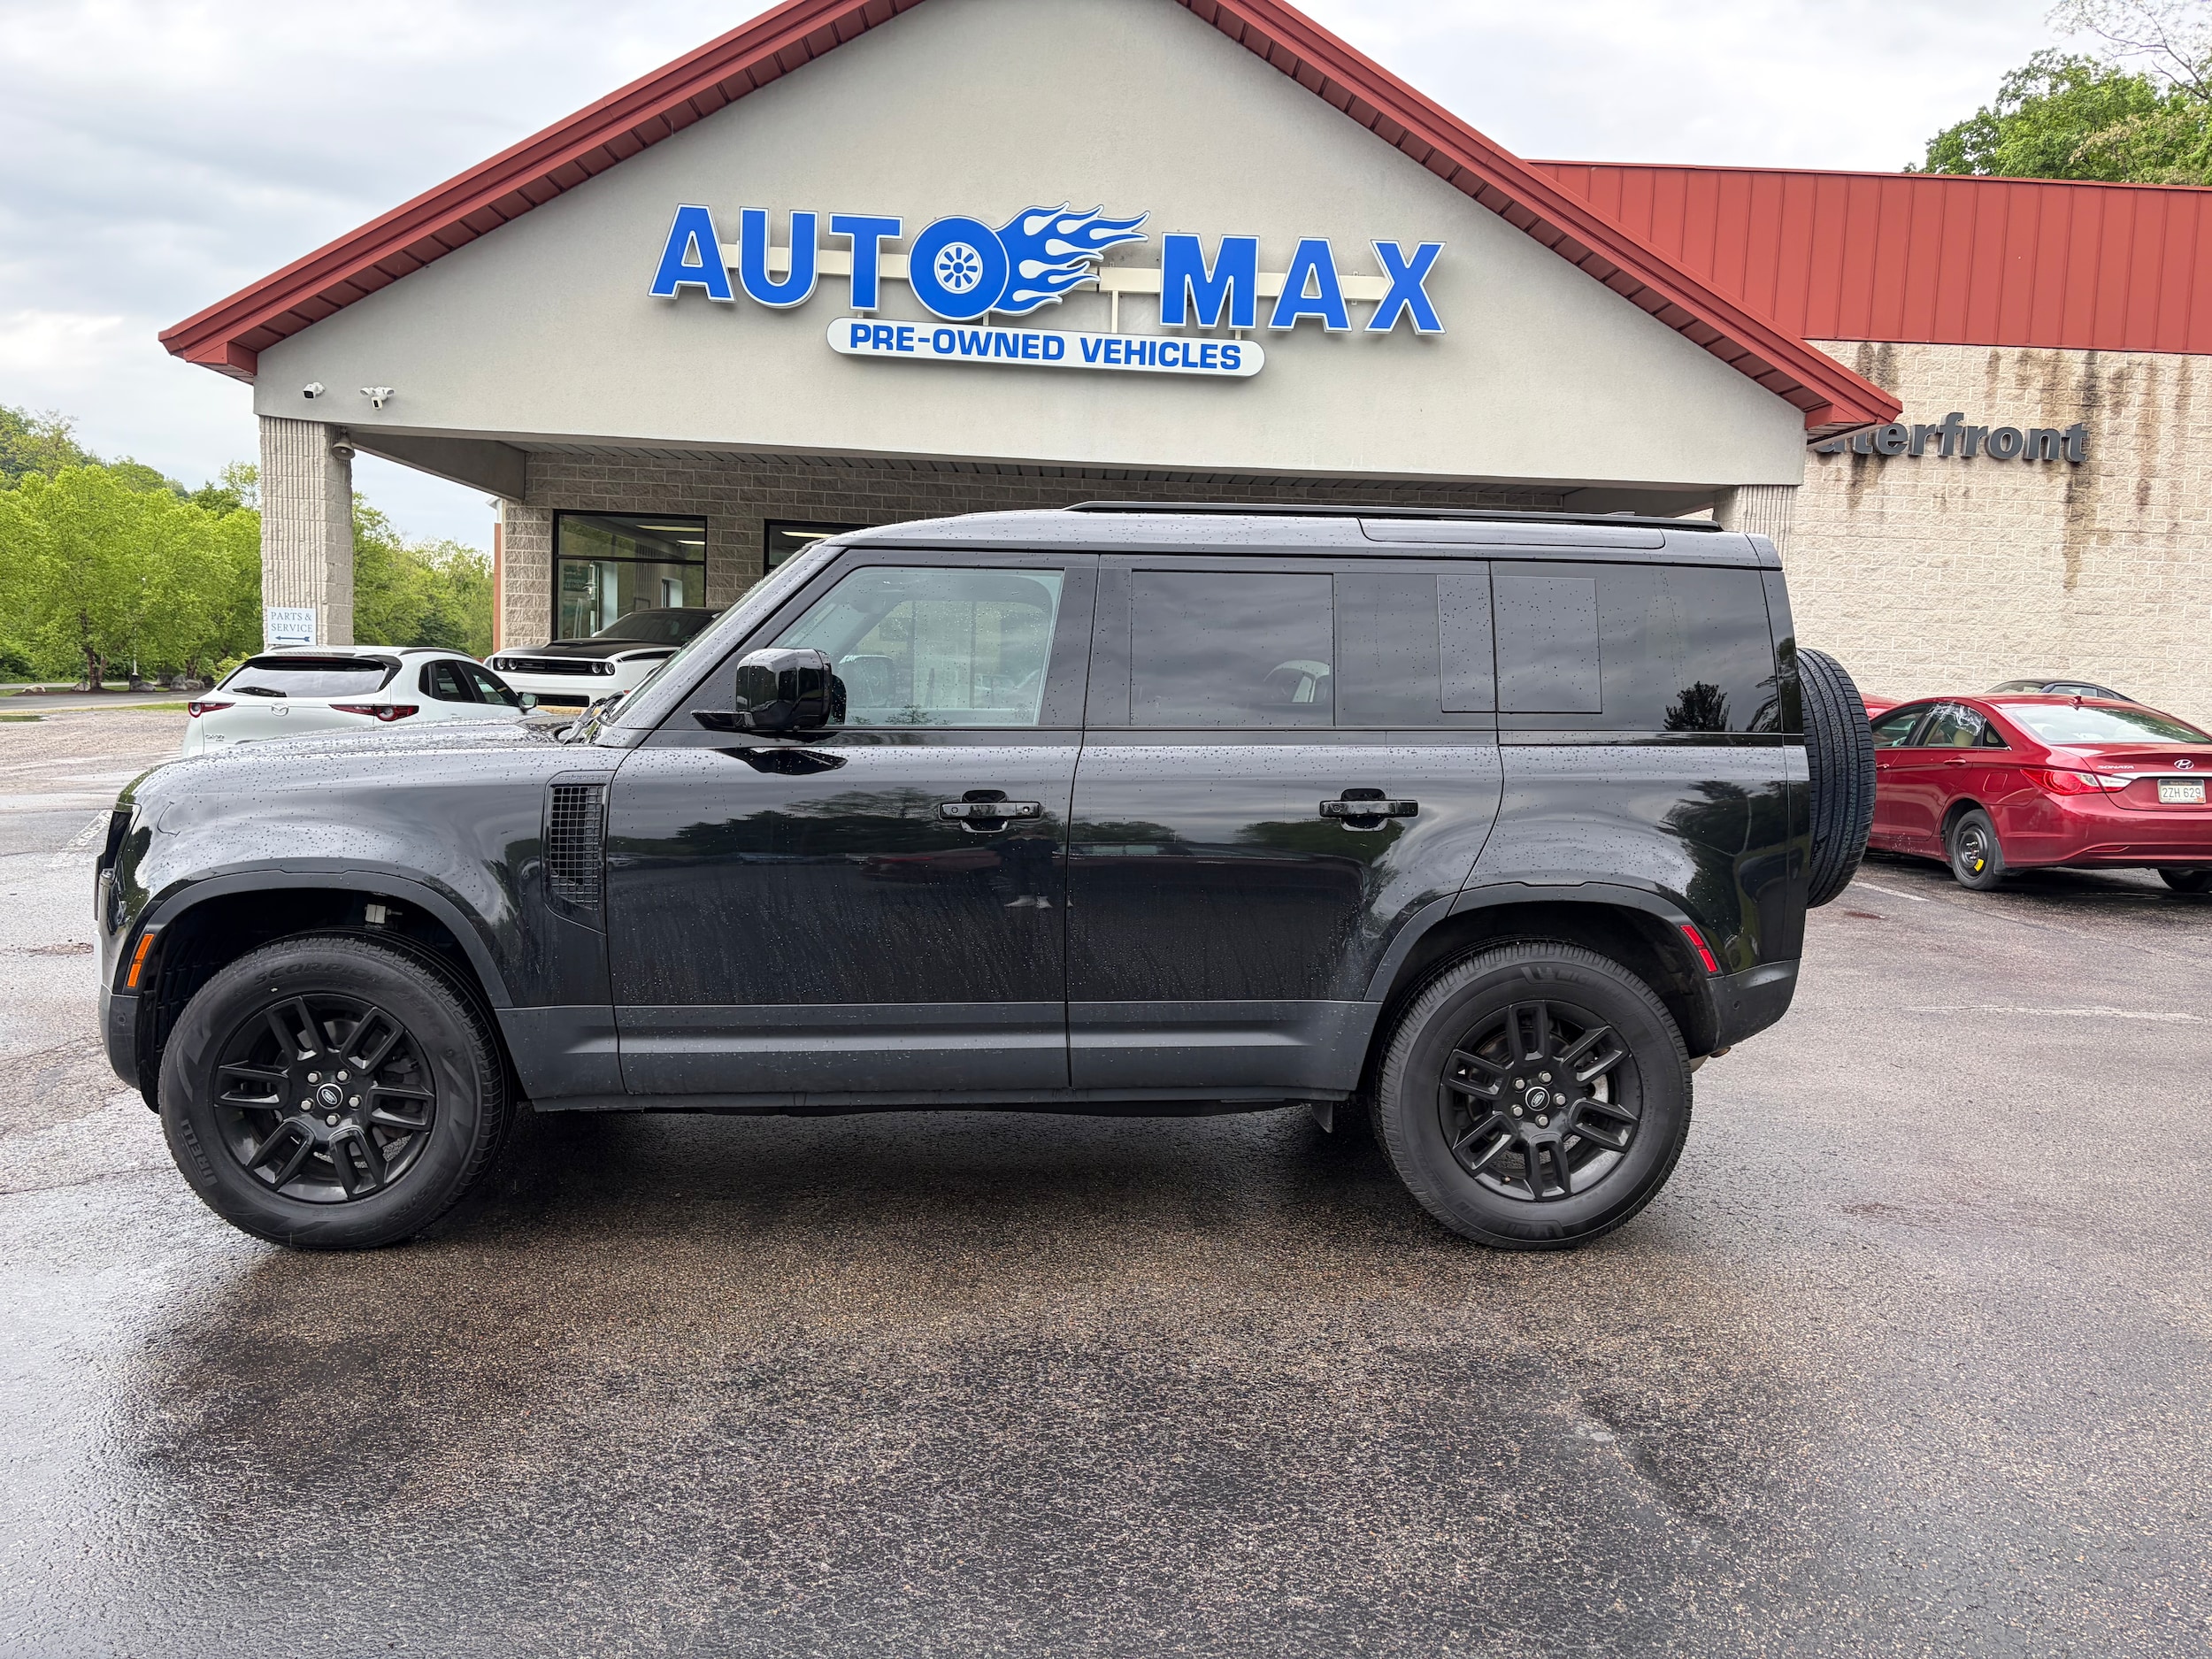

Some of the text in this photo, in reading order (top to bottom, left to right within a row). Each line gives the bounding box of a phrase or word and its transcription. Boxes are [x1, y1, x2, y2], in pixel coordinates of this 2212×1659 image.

[649, 204, 1448, 334] AUTO MAX
[849, 322, 1242, 371] PRE-OWNED VEHICLES
[271, 611, 312, 621] PARTS &
[271, 623, 313, 633] SERVICE
[2162, 787, 2201, 798] 2ZH 629
